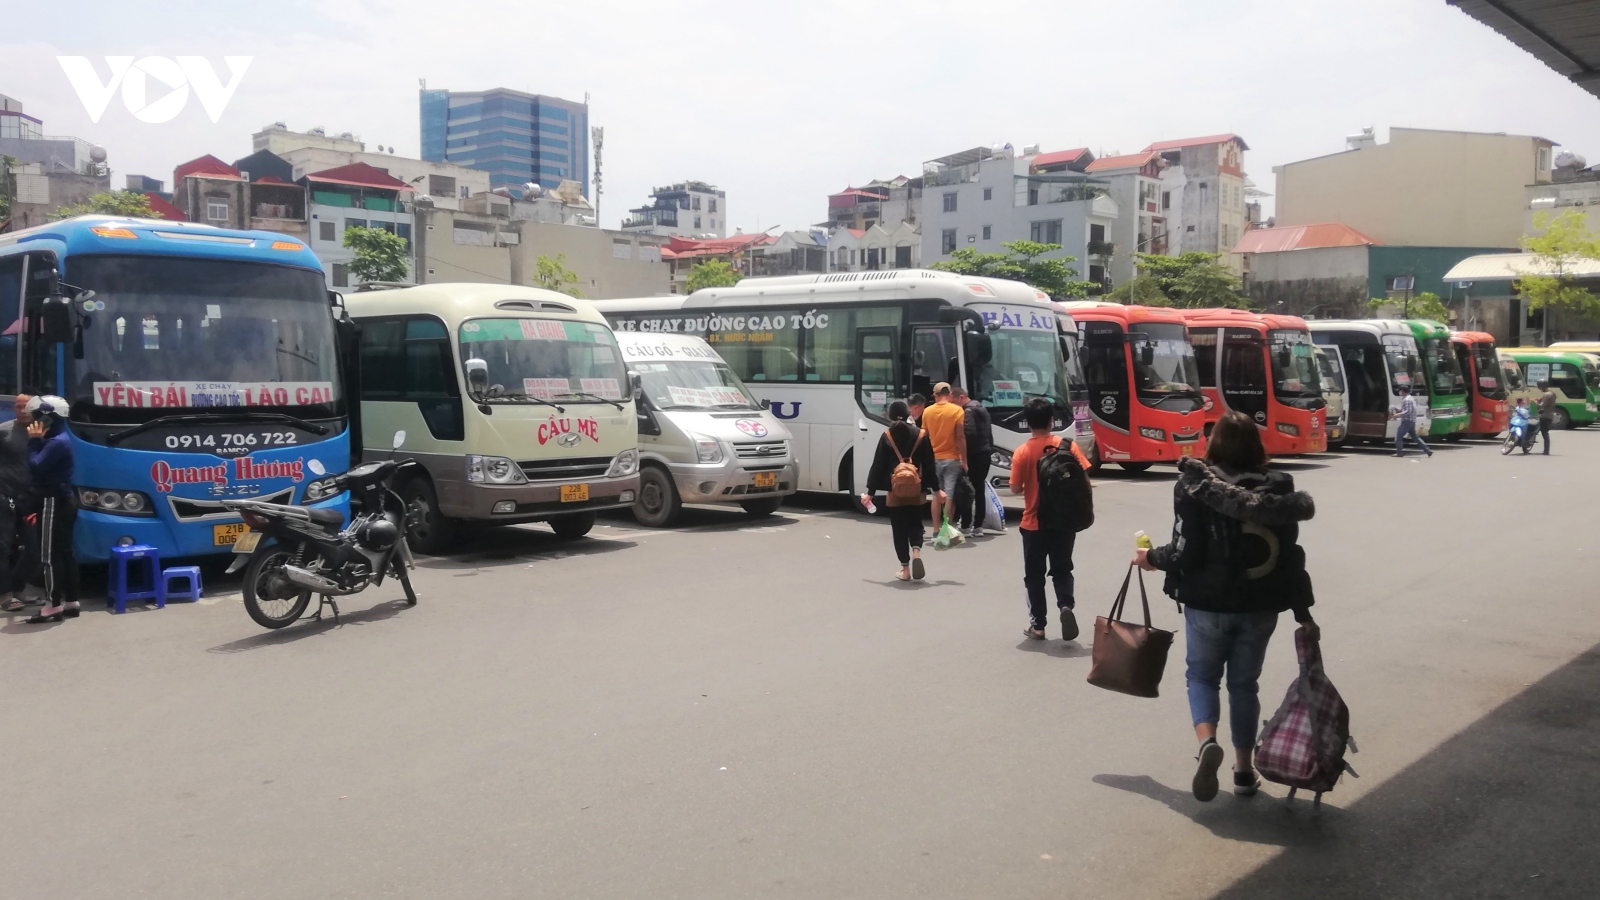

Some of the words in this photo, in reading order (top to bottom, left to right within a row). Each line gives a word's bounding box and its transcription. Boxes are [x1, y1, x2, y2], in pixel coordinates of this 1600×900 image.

[616, 320, 637, 332] XE
[684, 312, 746, 332] ĐƯỜNG
[747, 315, 786, 331] CAO
[791, 308, 829, 329] TỐC
[1029, 311, 1054, 330] ÂU
[97, 383, 142, 407] YÊN
[150, 383, 186, 407] BÁI
[245, 384, 289, 407] LÀO
[295, 386, 331, 406] CAI
[165, 434, 217, 449] 0914
[221, 433, 258, 446] 706
[261, 431, 298, 445] 722
[538, 413, 570, 446] CẦU
[577, 415, 599, 444] MÈ
[151, 459, 228, 493] Quang
[233, 456, 305, 483] Hương
[208, 484, 260, 496] ISUZU
[225, 523, 244, 534] 21B
[218, 534, 237, 545] 006
